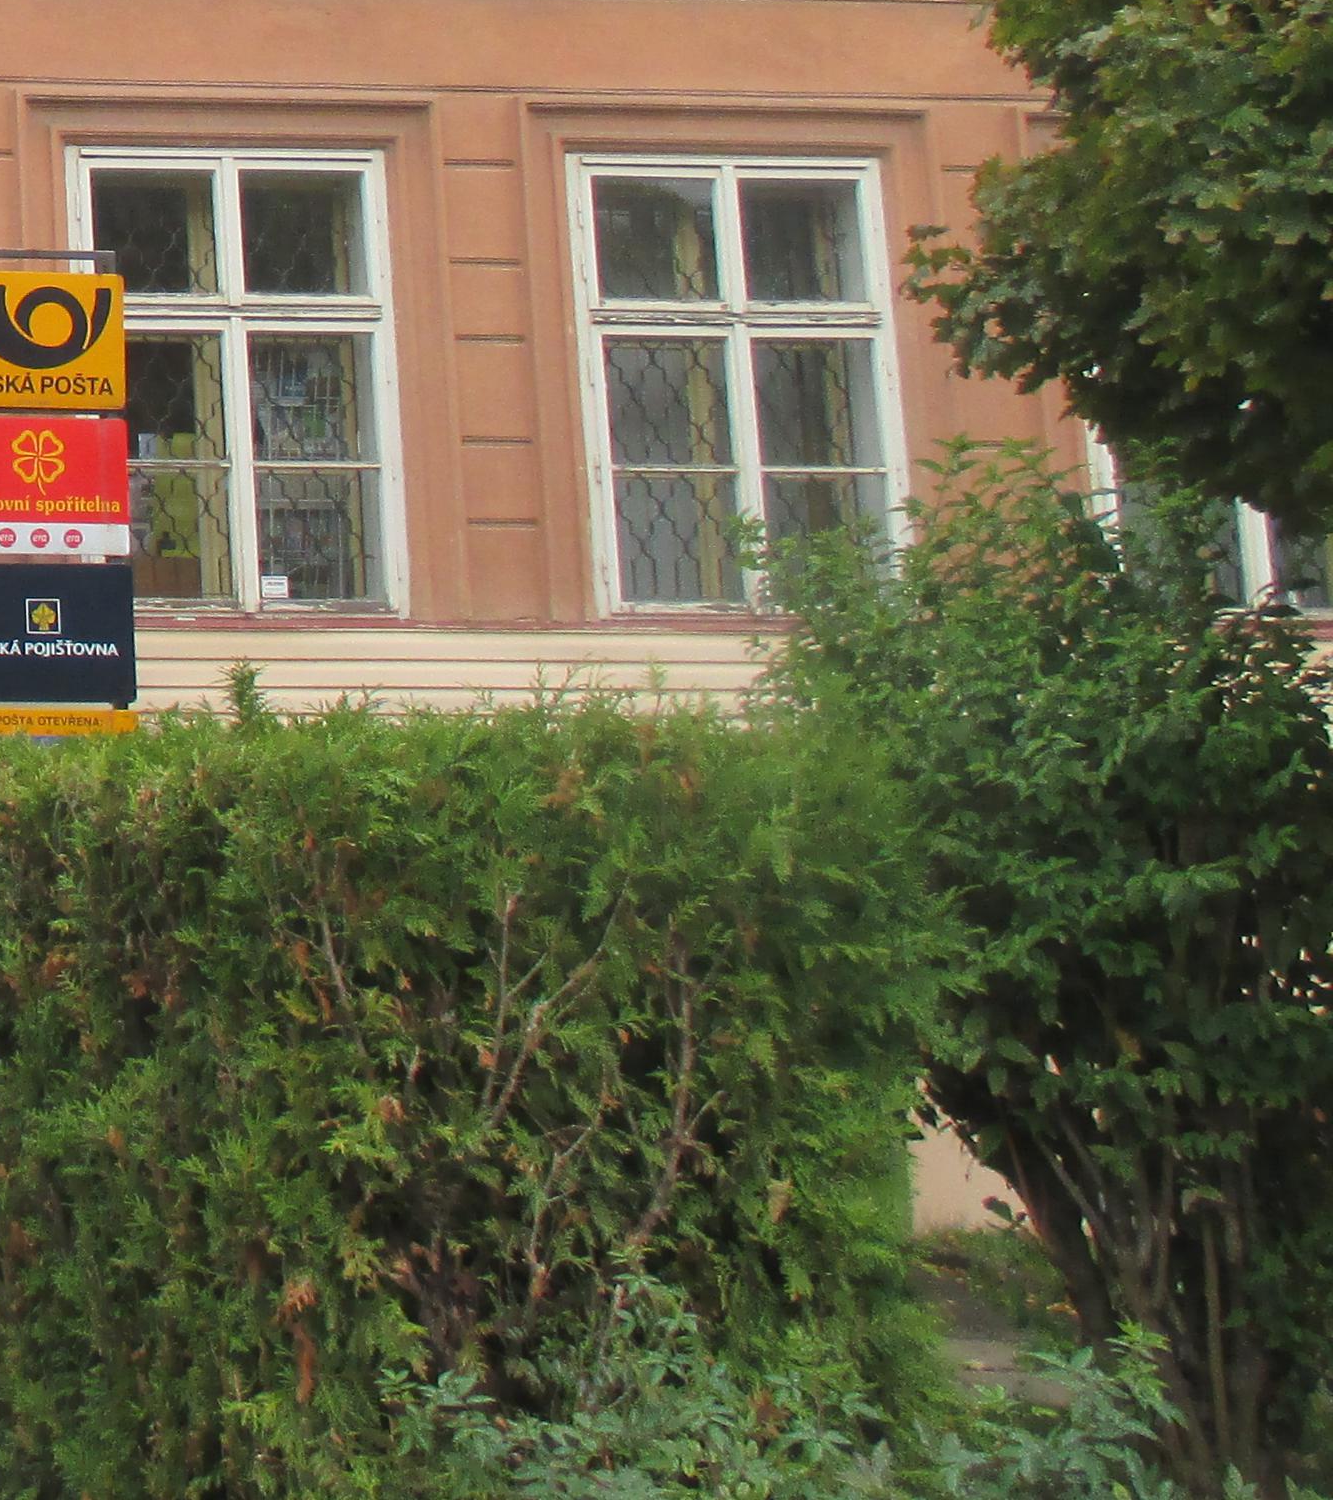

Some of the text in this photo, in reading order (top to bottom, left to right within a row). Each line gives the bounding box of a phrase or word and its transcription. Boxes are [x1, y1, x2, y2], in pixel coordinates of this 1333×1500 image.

[40, 373, 113, 396] POŠTA
[35, 495, 121, 516] spořitelna
[0, 533, 81, 543] era era era
[25, 640, 119, 657] POJIŠŤOVNA
